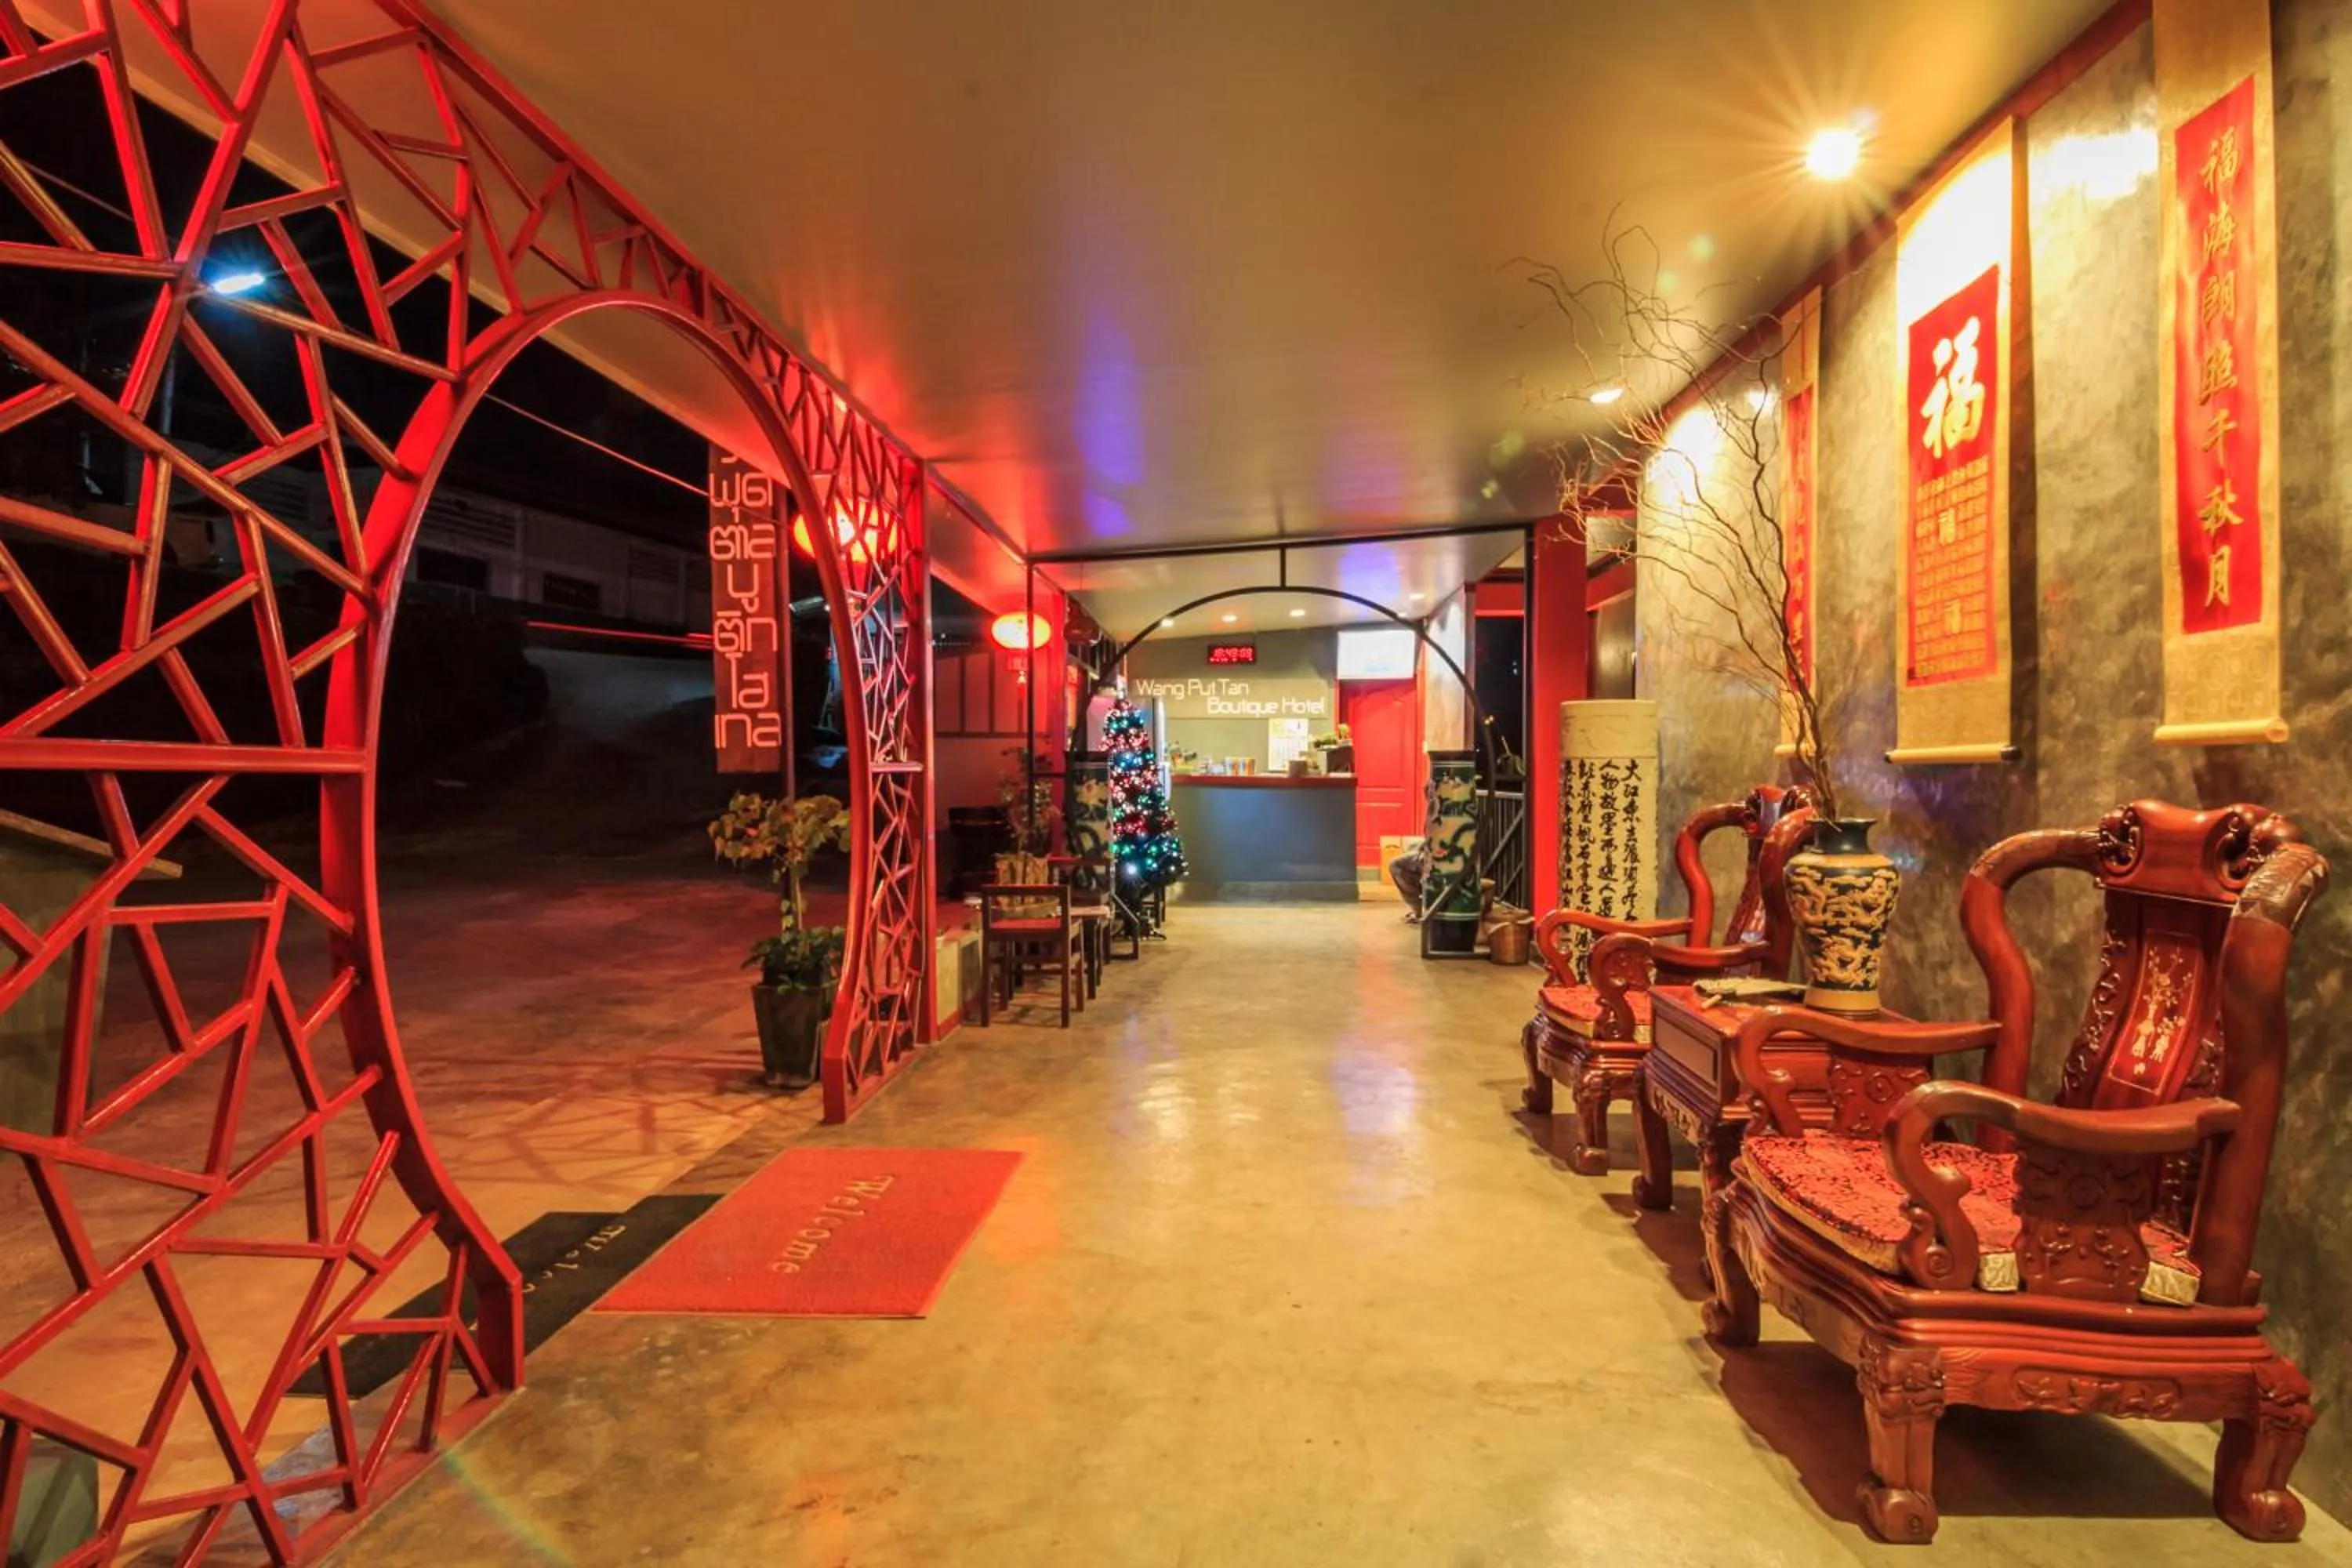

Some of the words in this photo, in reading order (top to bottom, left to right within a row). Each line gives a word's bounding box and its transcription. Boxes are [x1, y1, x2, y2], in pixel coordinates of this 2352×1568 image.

[1920, 315, 1984, 459] 福
[1136, 680, 1185, 699] Wang
[1218, 679, 1250, 695] Tan
[1207, 697, 1279, 717] Boutique
[1282, 697, 1325, 714] Hotel
[771, 1174, 895, 1273] Welcome
